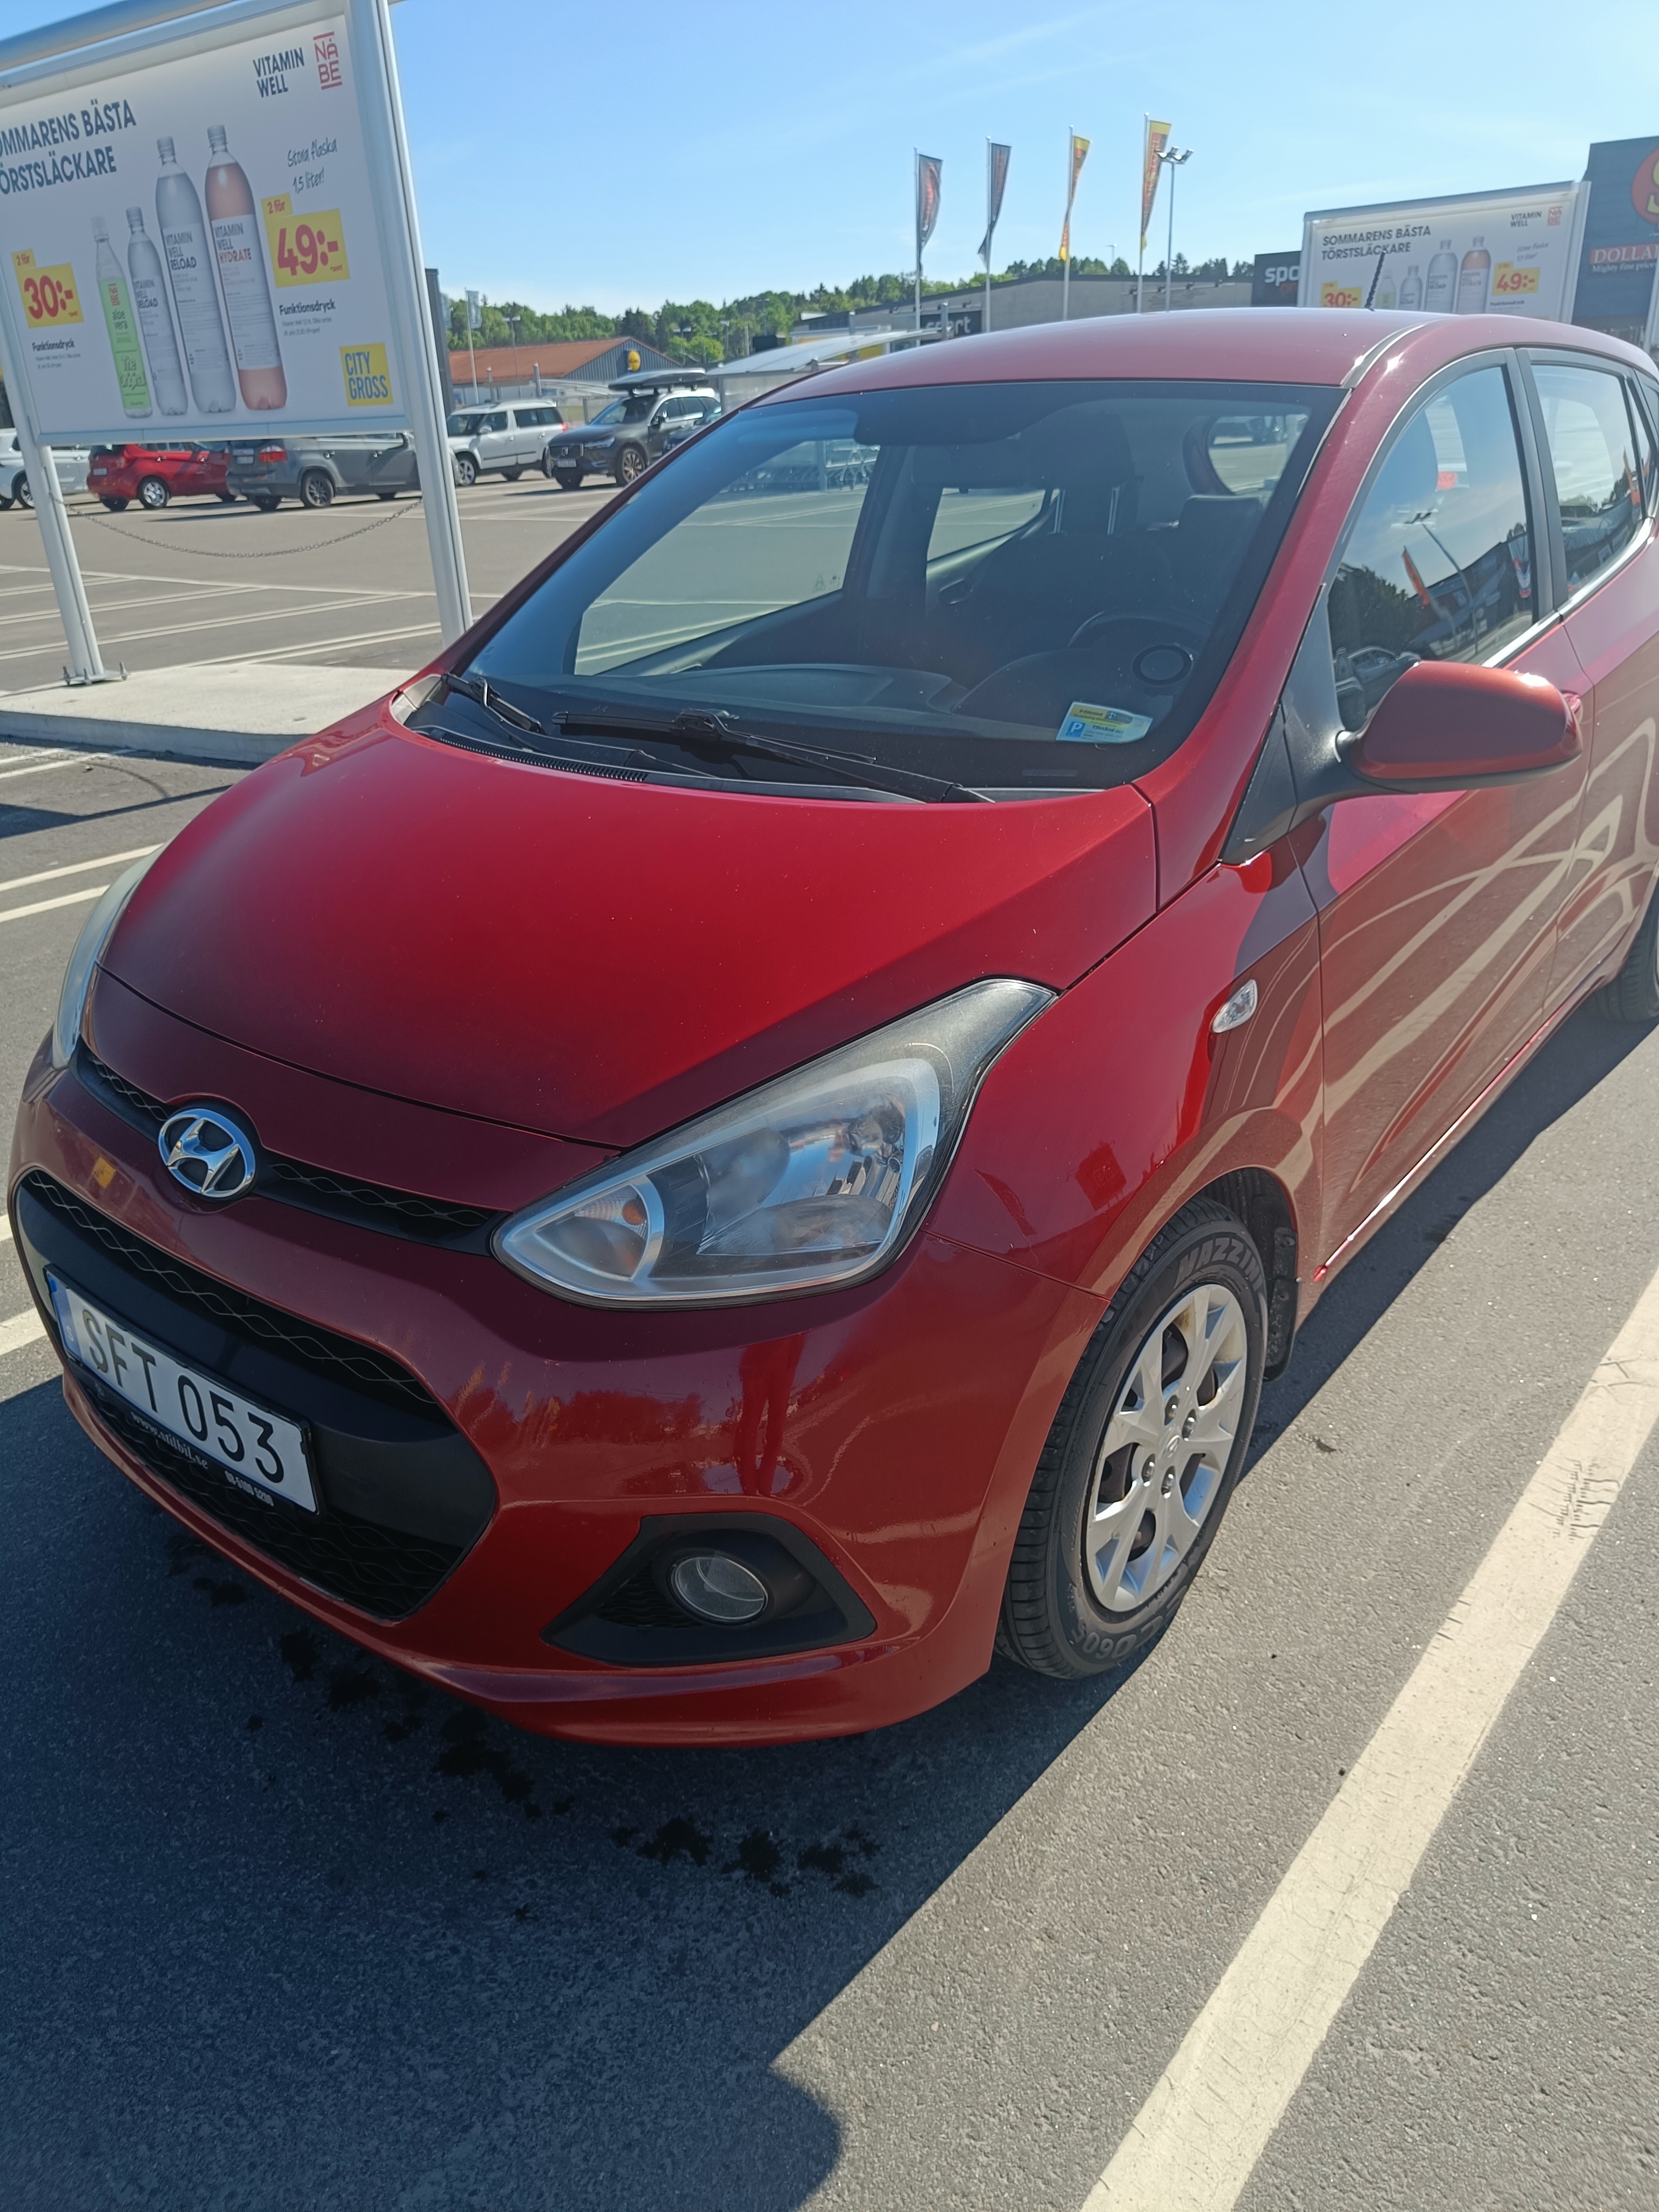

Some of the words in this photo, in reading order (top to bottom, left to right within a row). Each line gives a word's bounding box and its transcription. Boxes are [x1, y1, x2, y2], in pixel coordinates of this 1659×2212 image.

[252, 46, 305, 77] VITAMIN
[257, 73, 288, 98] WELL
[80, 98, 137, 137] BÄSTA
[267, 201, 274, 214] 2
[1510, 211, 1542, 221] VITAMIN
[1509, 220, 1528, 228] WELL
[1322, 228, 1393, 246] SOMMARENS
[1395, 224, 1432, 239] BÄSTA
[16, 254, 22, 266] 2
[277, 224, 339, 276] 49:-
[1321, 241, 1412, 260] TÖRSTSLÄCKARE
[1594, 245, 1658, 264] DOLLA
[1496, 273, 1535, 292] 49:-
[23, 275, 74, 320] 30:-
[279, 298, 336, 315] Funktionsdryck
[31, 338, 76, 352] Funktionsdryck
[345, 351, 370, 376] CITY
[348, 375, 389, 401] GROSS
[1174, 1237, 1263, 1292] MAZZINI
[66, 1325, 75, 1342] S
[82, 1309, 158, 1414] SFT
[178, 1374, 284, 1483] 053
